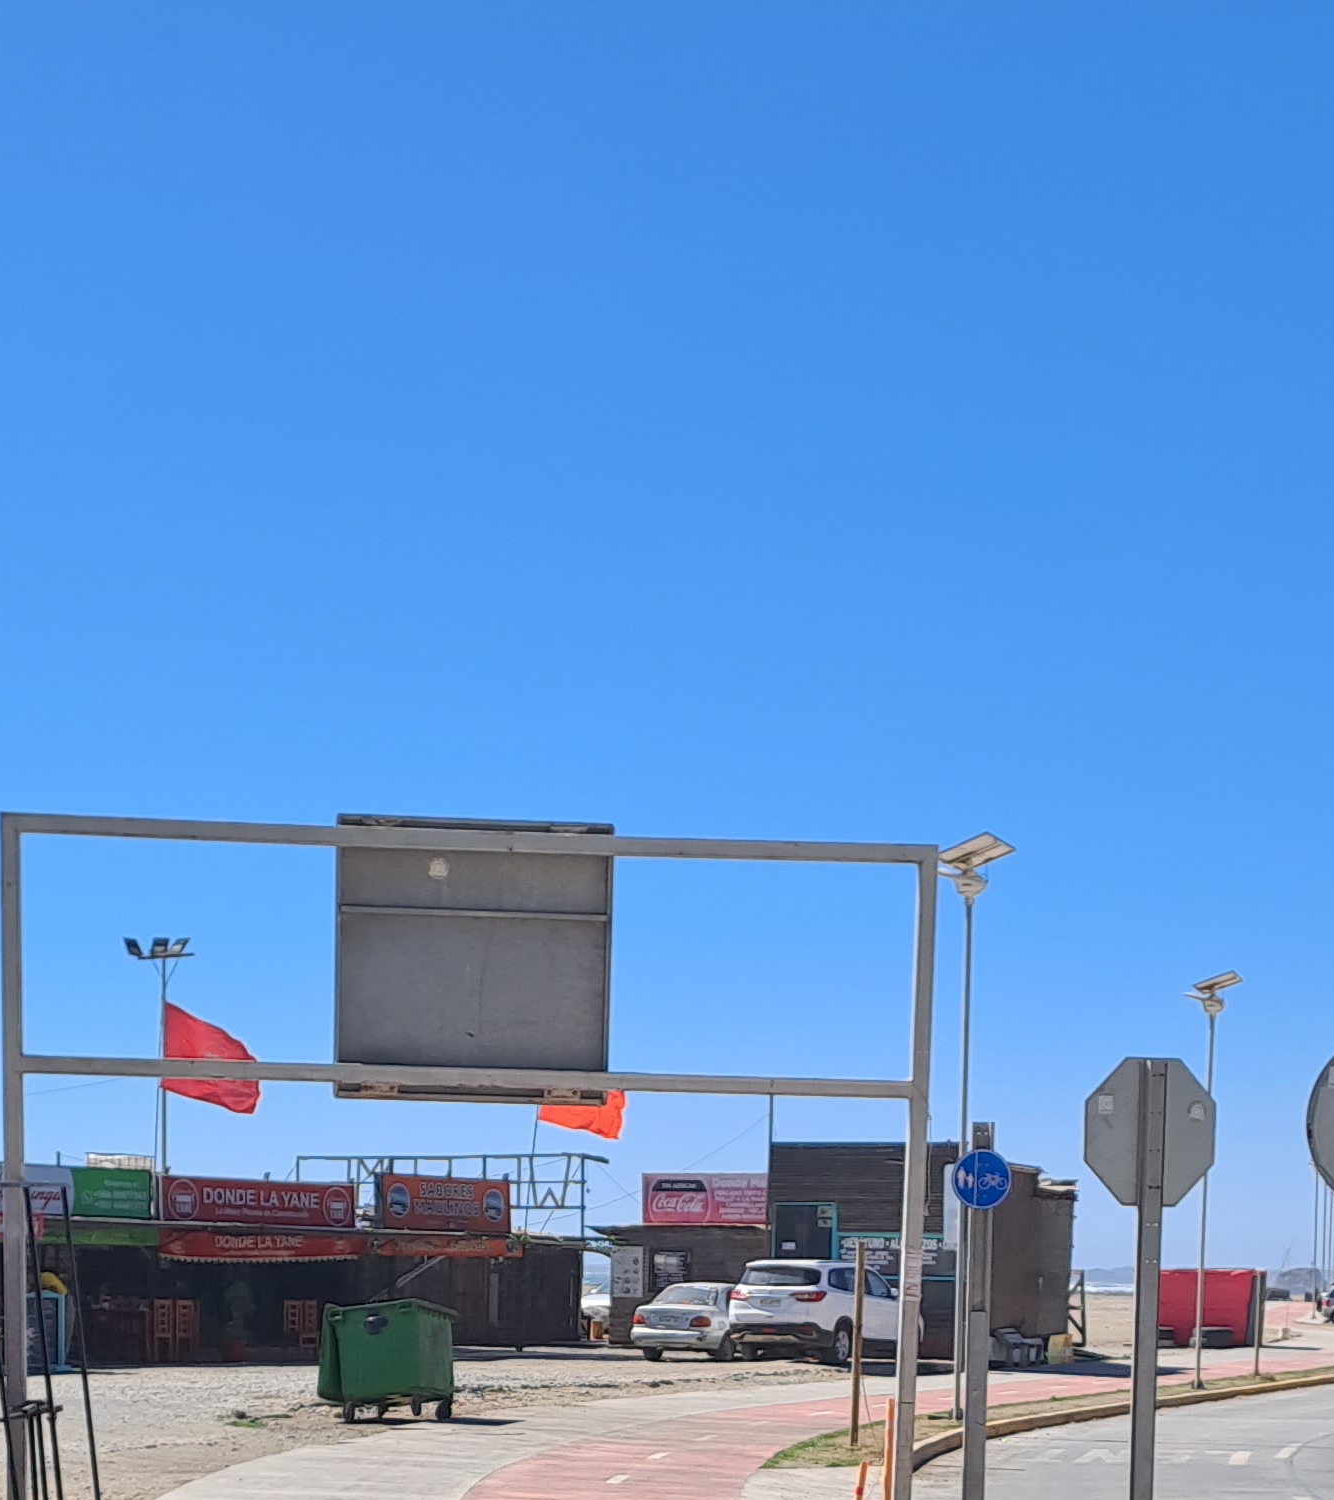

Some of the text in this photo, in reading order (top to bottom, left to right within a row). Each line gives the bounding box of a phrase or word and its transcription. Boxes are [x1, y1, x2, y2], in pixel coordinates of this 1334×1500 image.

[203, 1187, 321, 1210] DONDE LA YANE
[419, 1181, 475, 1200] SABORES
[214, 1235, 304, 1249] DONDE LA YANE
